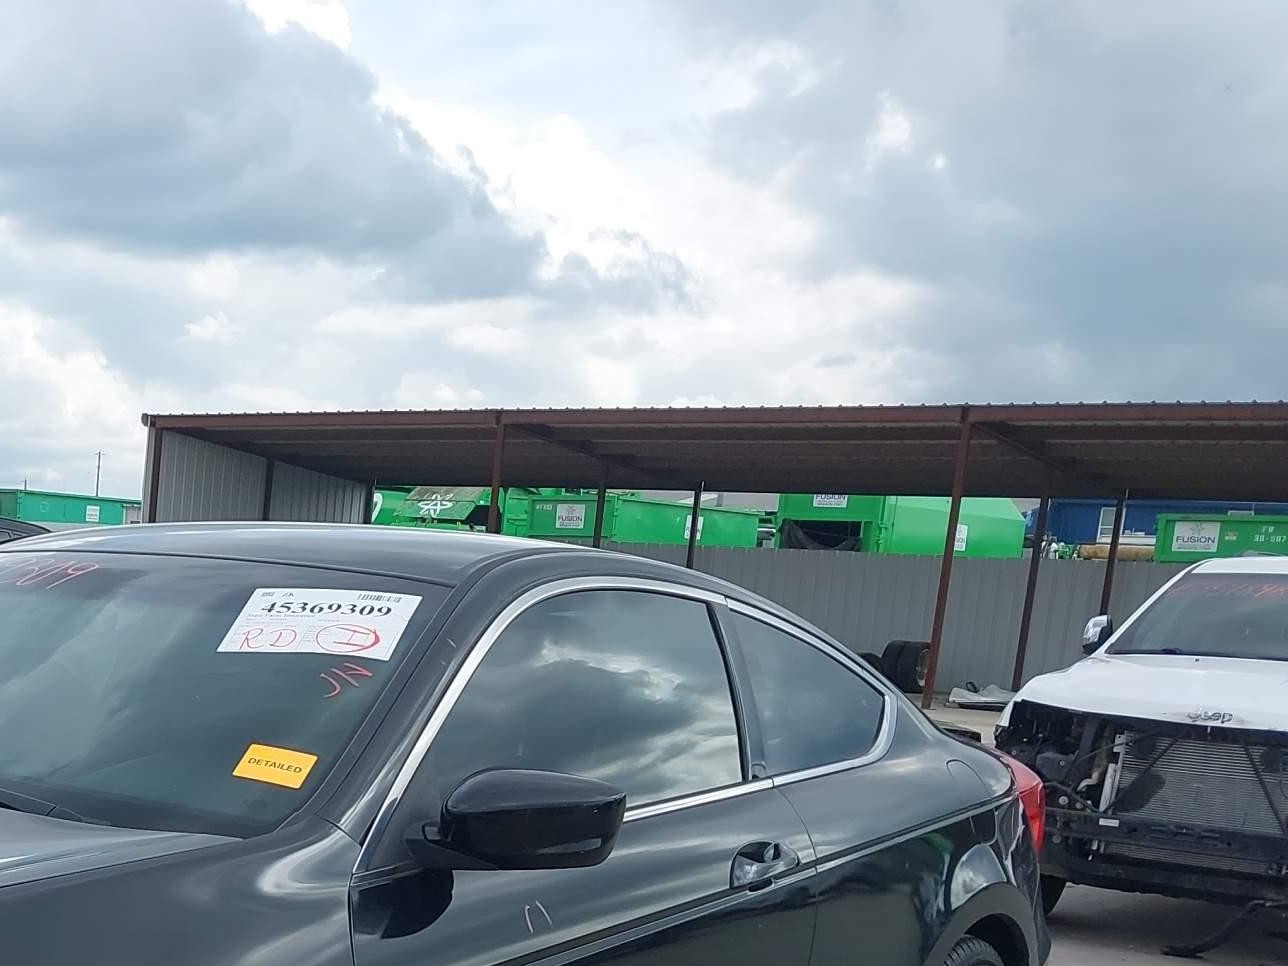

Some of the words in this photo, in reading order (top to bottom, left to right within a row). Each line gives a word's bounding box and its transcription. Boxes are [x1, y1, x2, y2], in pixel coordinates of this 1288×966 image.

[1175, 535, 1216, 544] FUSION
[261, 601, 393, 618] 45369309
[247, 757, 303, 774] DETAILED
